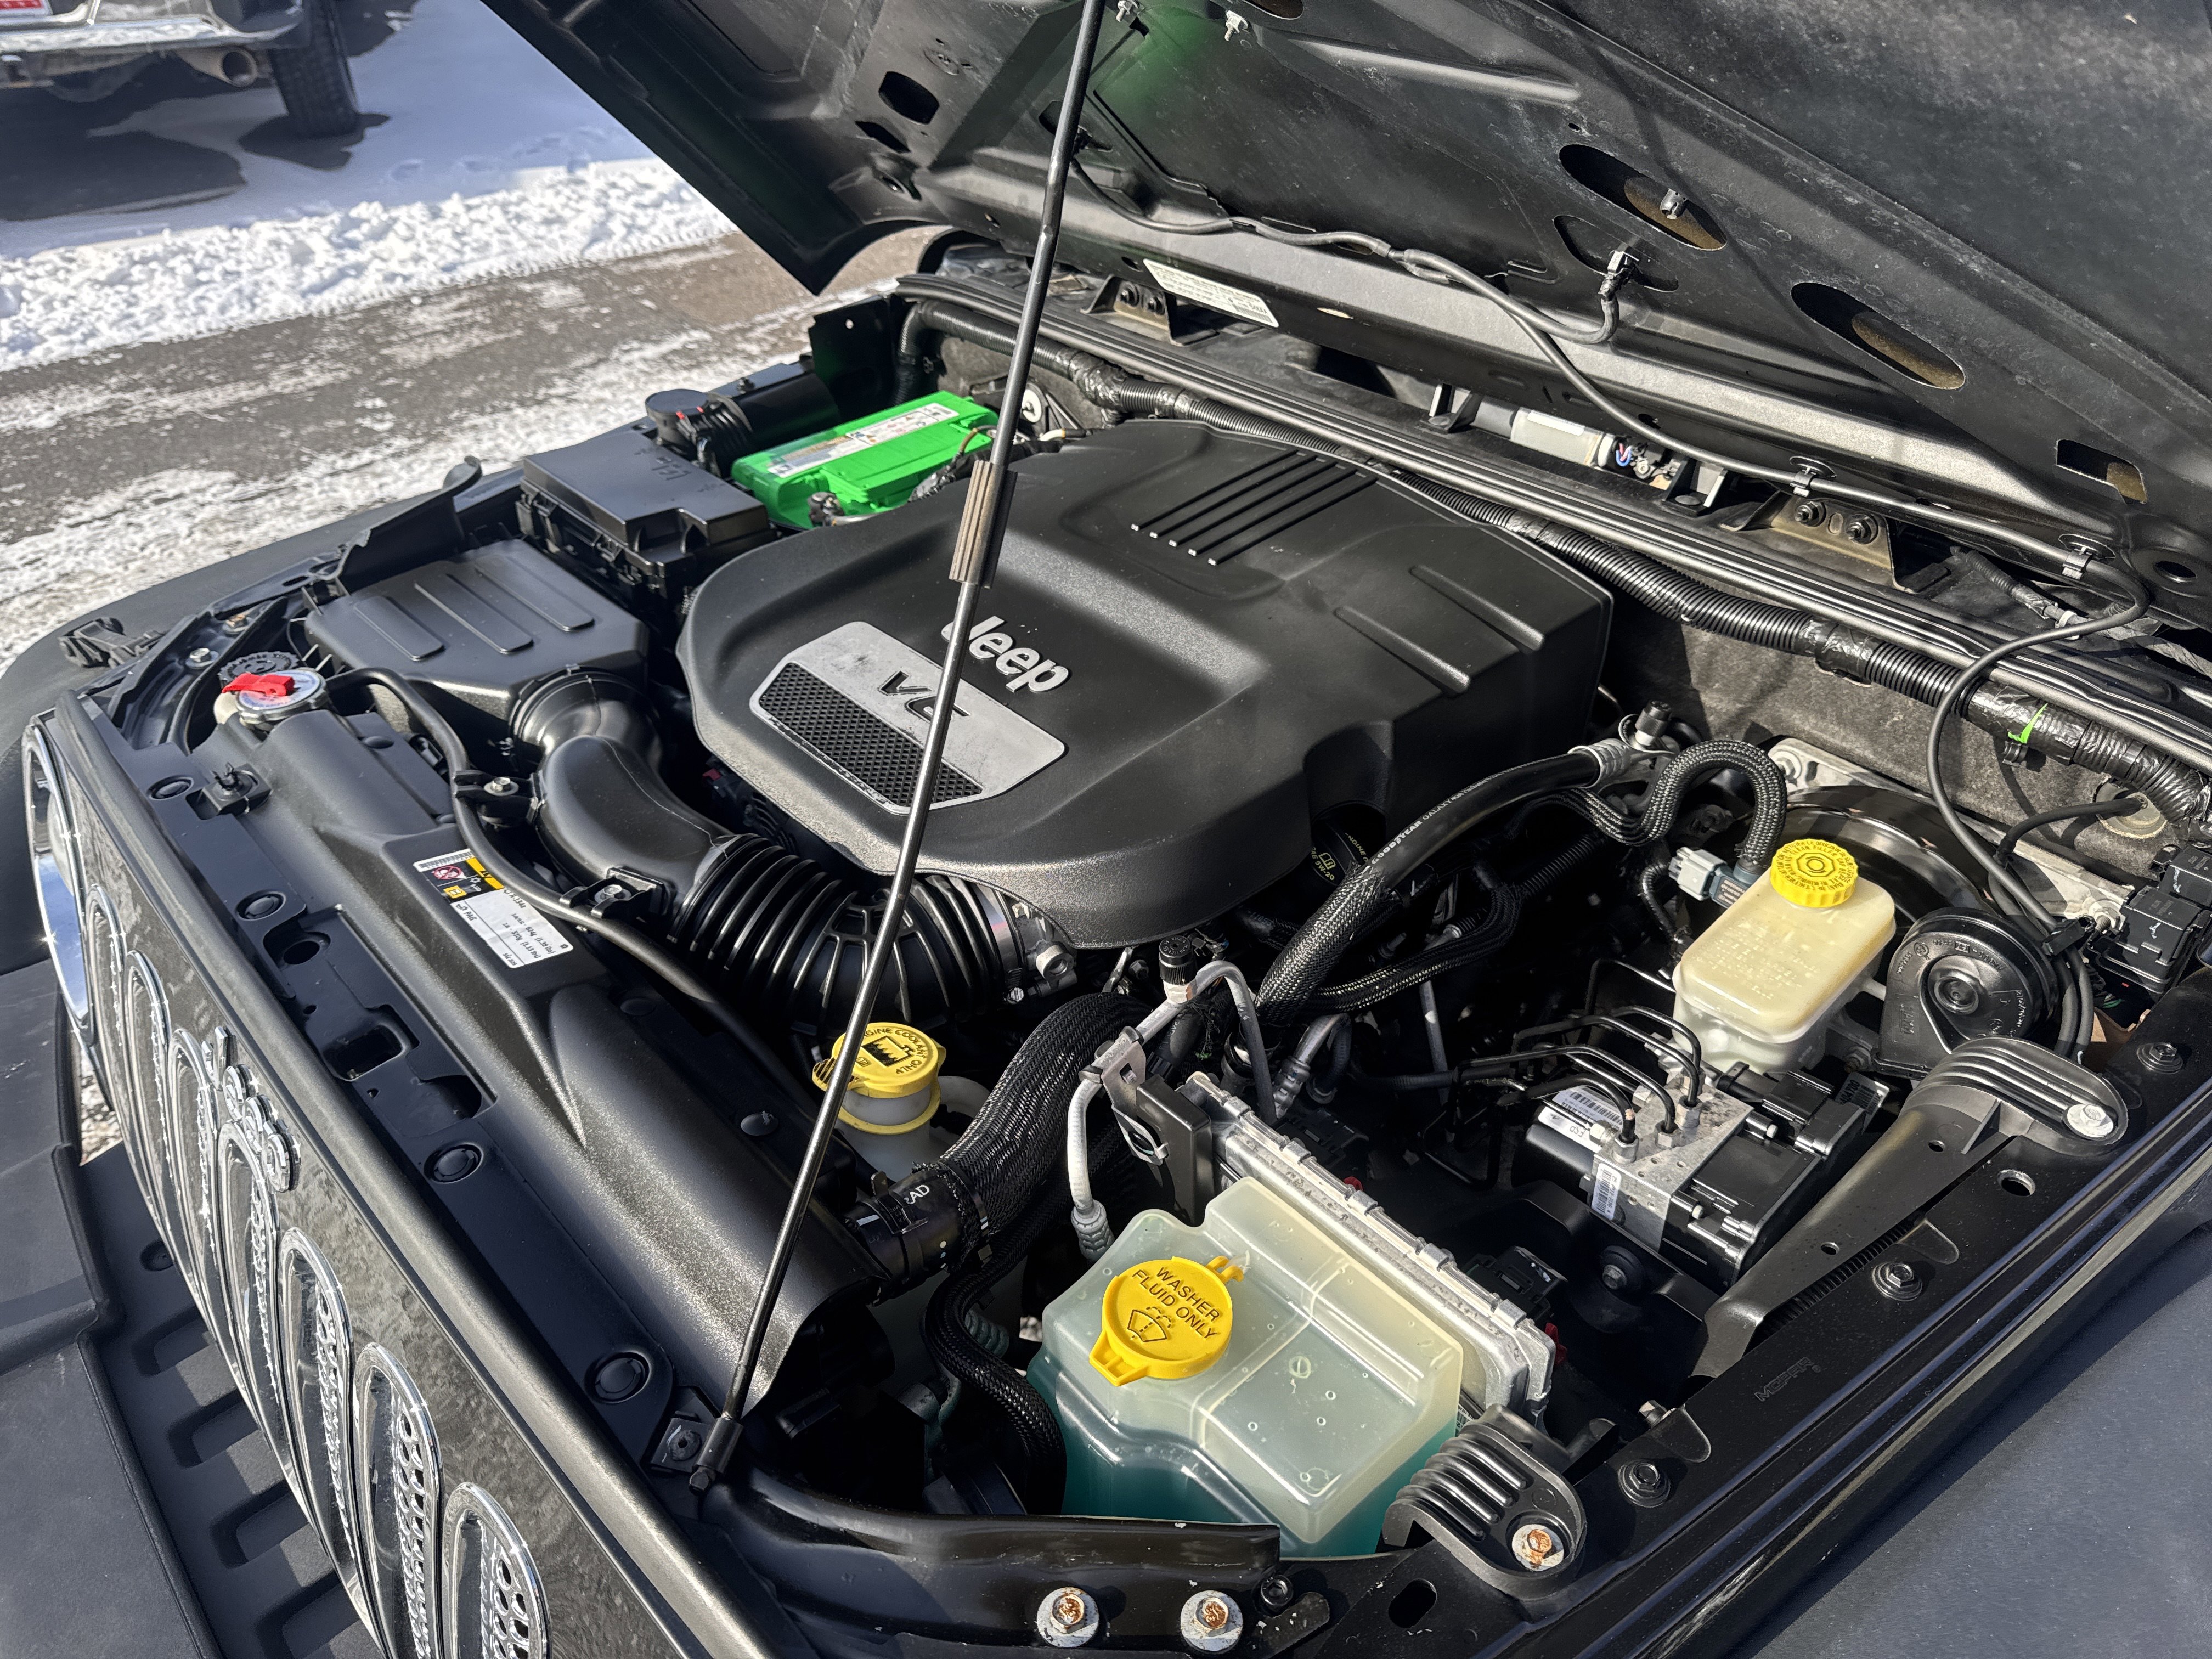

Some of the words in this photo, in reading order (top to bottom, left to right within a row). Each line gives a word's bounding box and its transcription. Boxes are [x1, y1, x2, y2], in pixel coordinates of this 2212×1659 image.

[941, 616, 1069, 693] Jeep
[1371, 820, 1423, 864] GOODYEAR
[1423, 799, 1452, 820] GALAXY
[1315, 861, 1334, 881] 5W-20
[464, 912, 477, 921] PAG
[864, 1028, 893, 1037] GINE
[895, 1030, 927, 1059] COOLANT
[895, 1060, 922, 1074] ONLY
[201, 1026, 292, 1194] Jeep
[1570, 1125, 1586, 1138] ESP
[1132, 1269, 1175, 1306] FLUID
[1176, 1306, 1218, 1339] ONLY
[1156, 1267, 1220, 1322] WASHER
